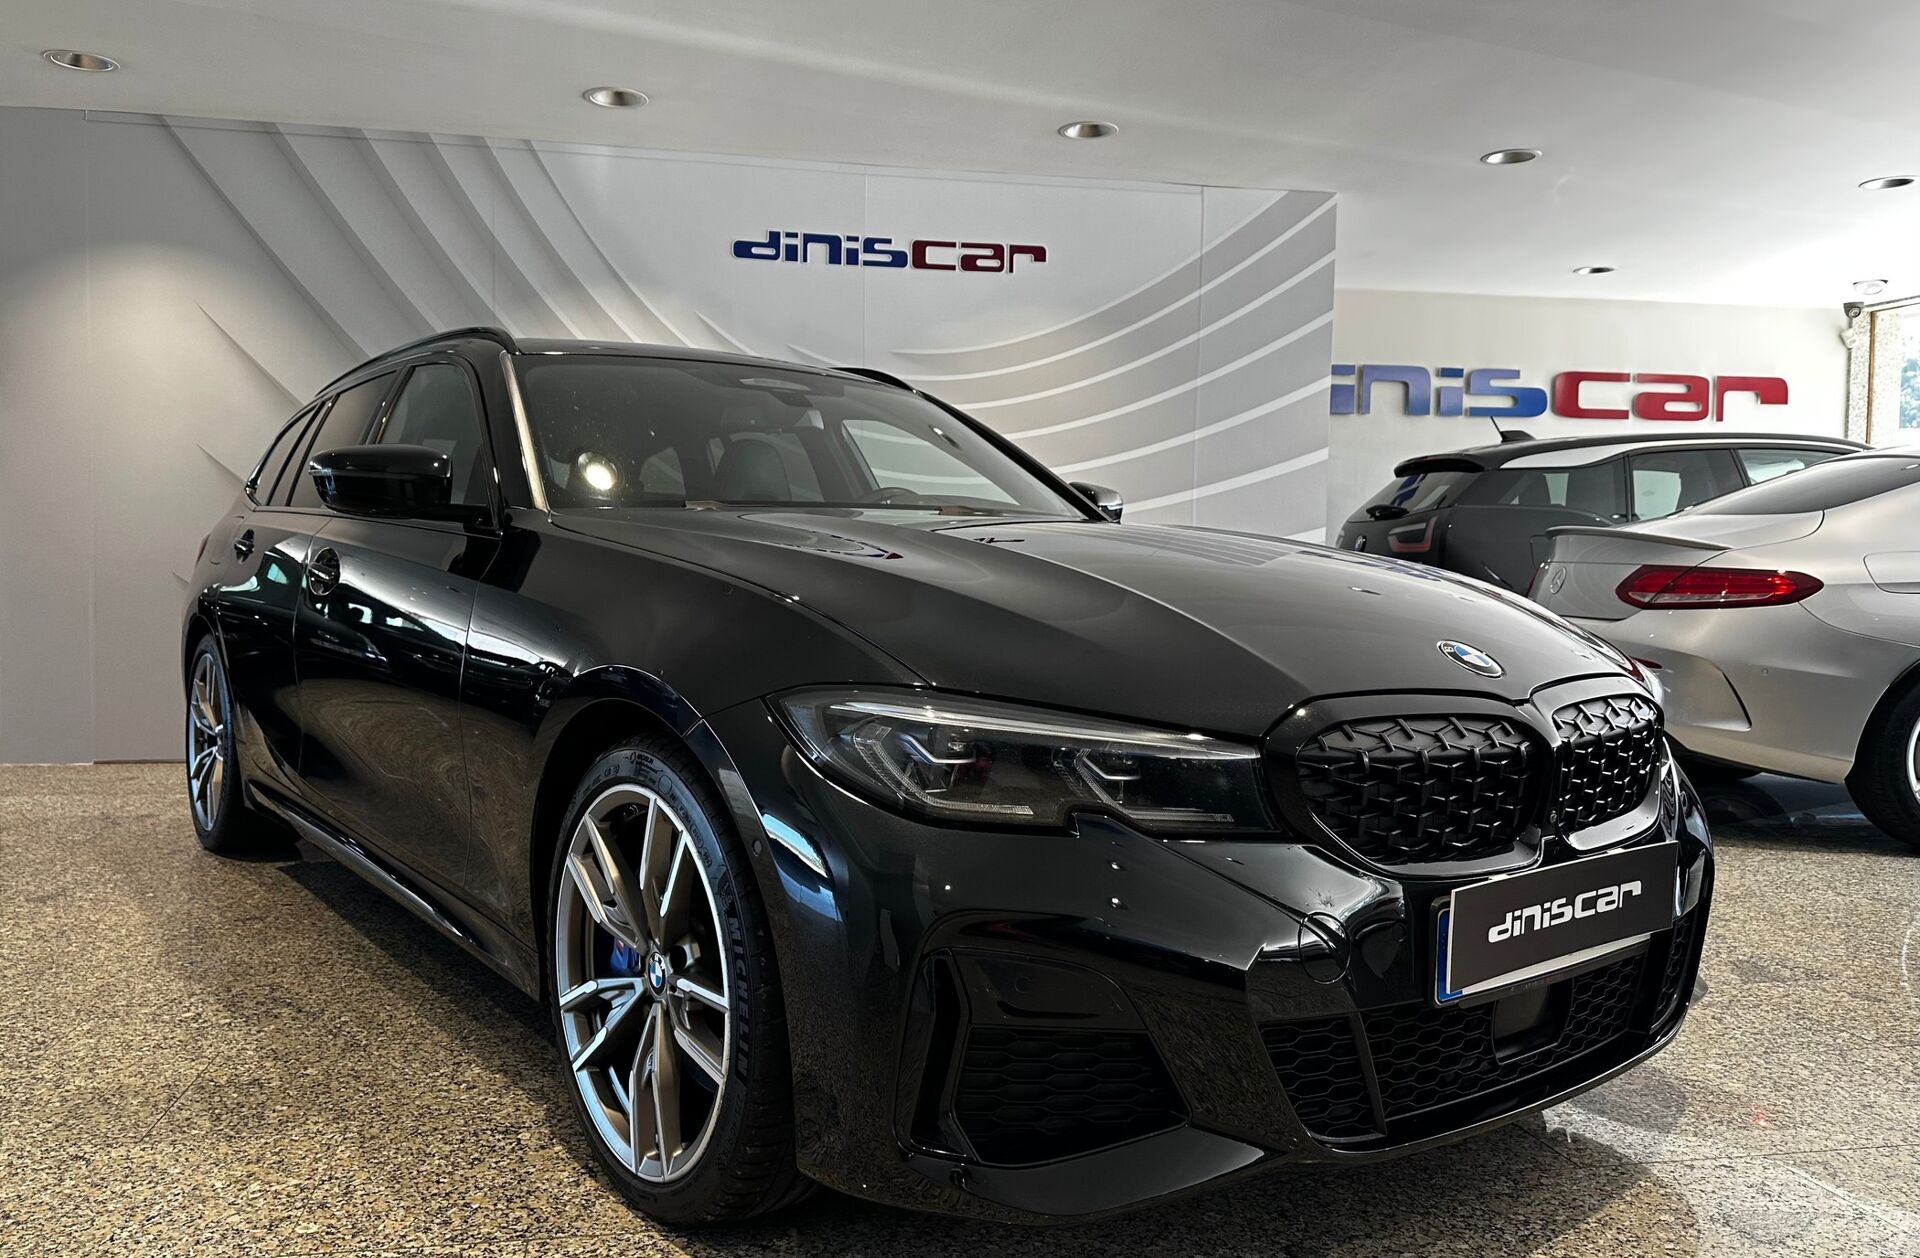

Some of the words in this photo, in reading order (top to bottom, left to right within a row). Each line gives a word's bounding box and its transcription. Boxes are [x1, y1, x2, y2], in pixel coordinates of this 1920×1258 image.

[732, 230, 1047, 274] diniscar
[1331, 364, 1789, 422] iniscar
[1488, 880, 1642, 943] diniscar
[727, 917, 750, 1078] MICHELIN
